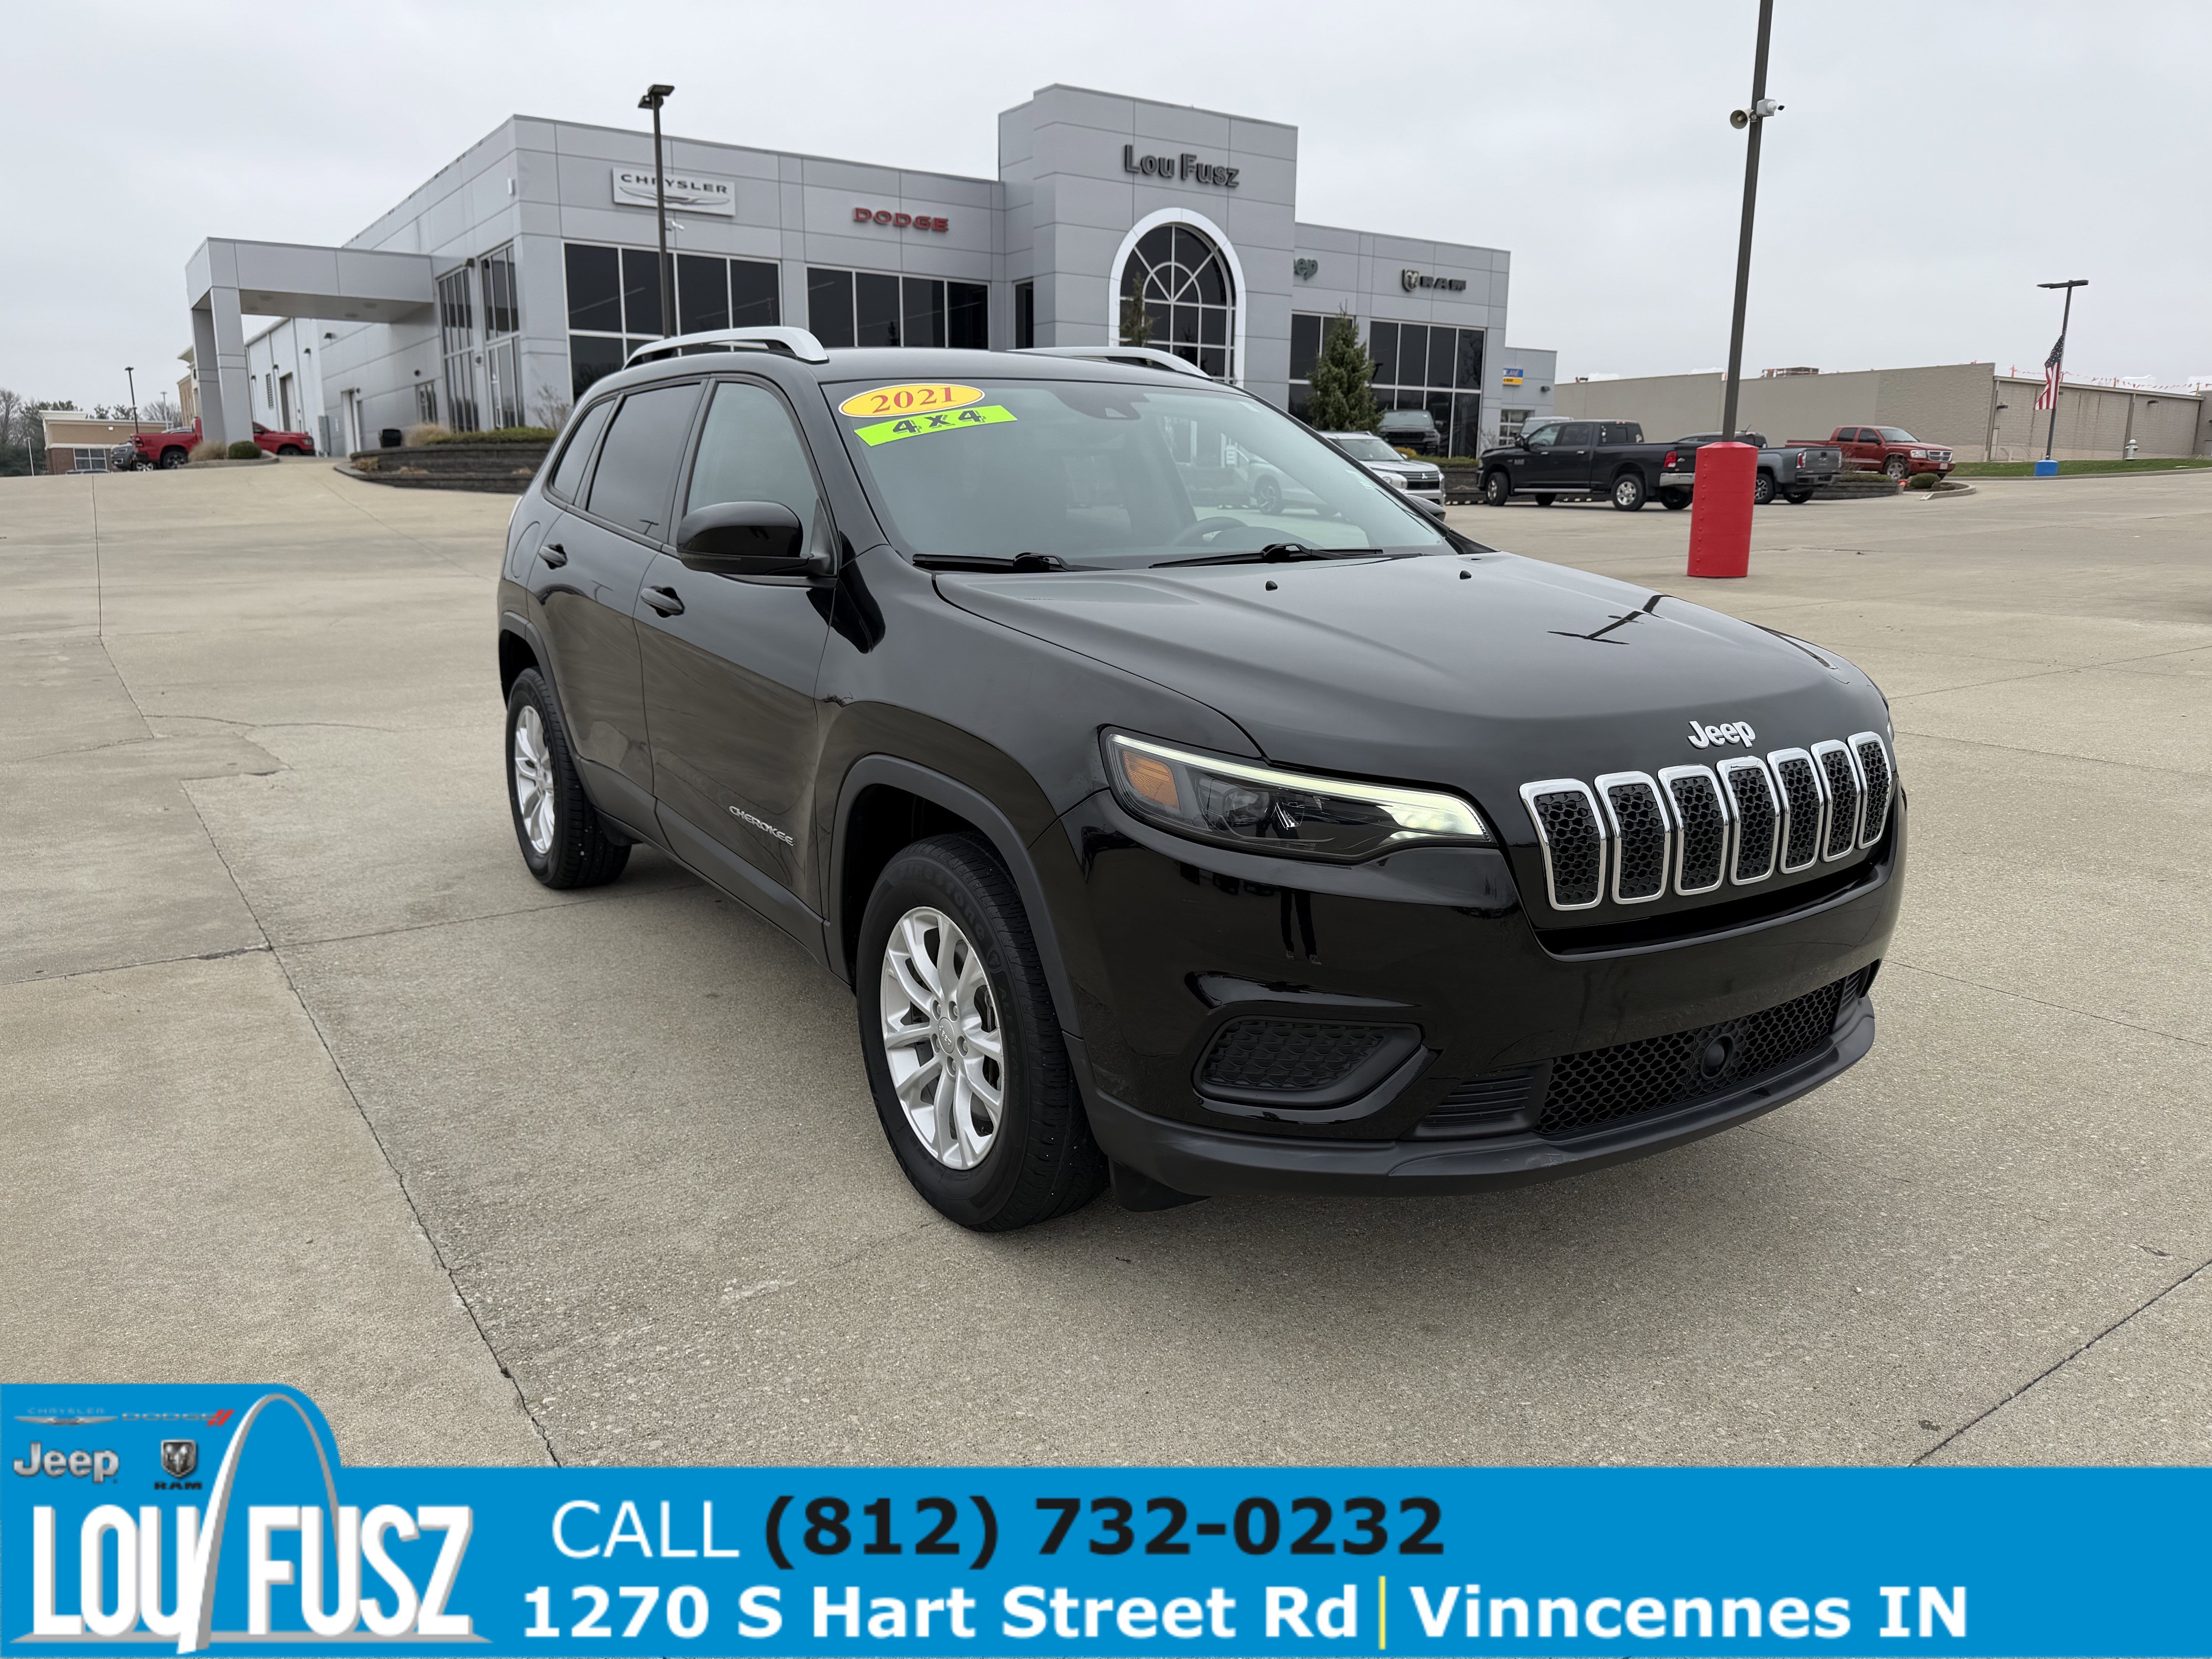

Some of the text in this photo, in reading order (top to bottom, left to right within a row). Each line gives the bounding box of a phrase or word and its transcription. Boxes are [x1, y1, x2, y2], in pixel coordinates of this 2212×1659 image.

[1124, 144, 1240, 187] Lou Fusz
[853, 207, 949, 234] DODGE
[870, 387, 957, 414] 2021
[1687, 720, 1756, 749] Jeep
[729, 805, 794, 847] CHEROKEE
